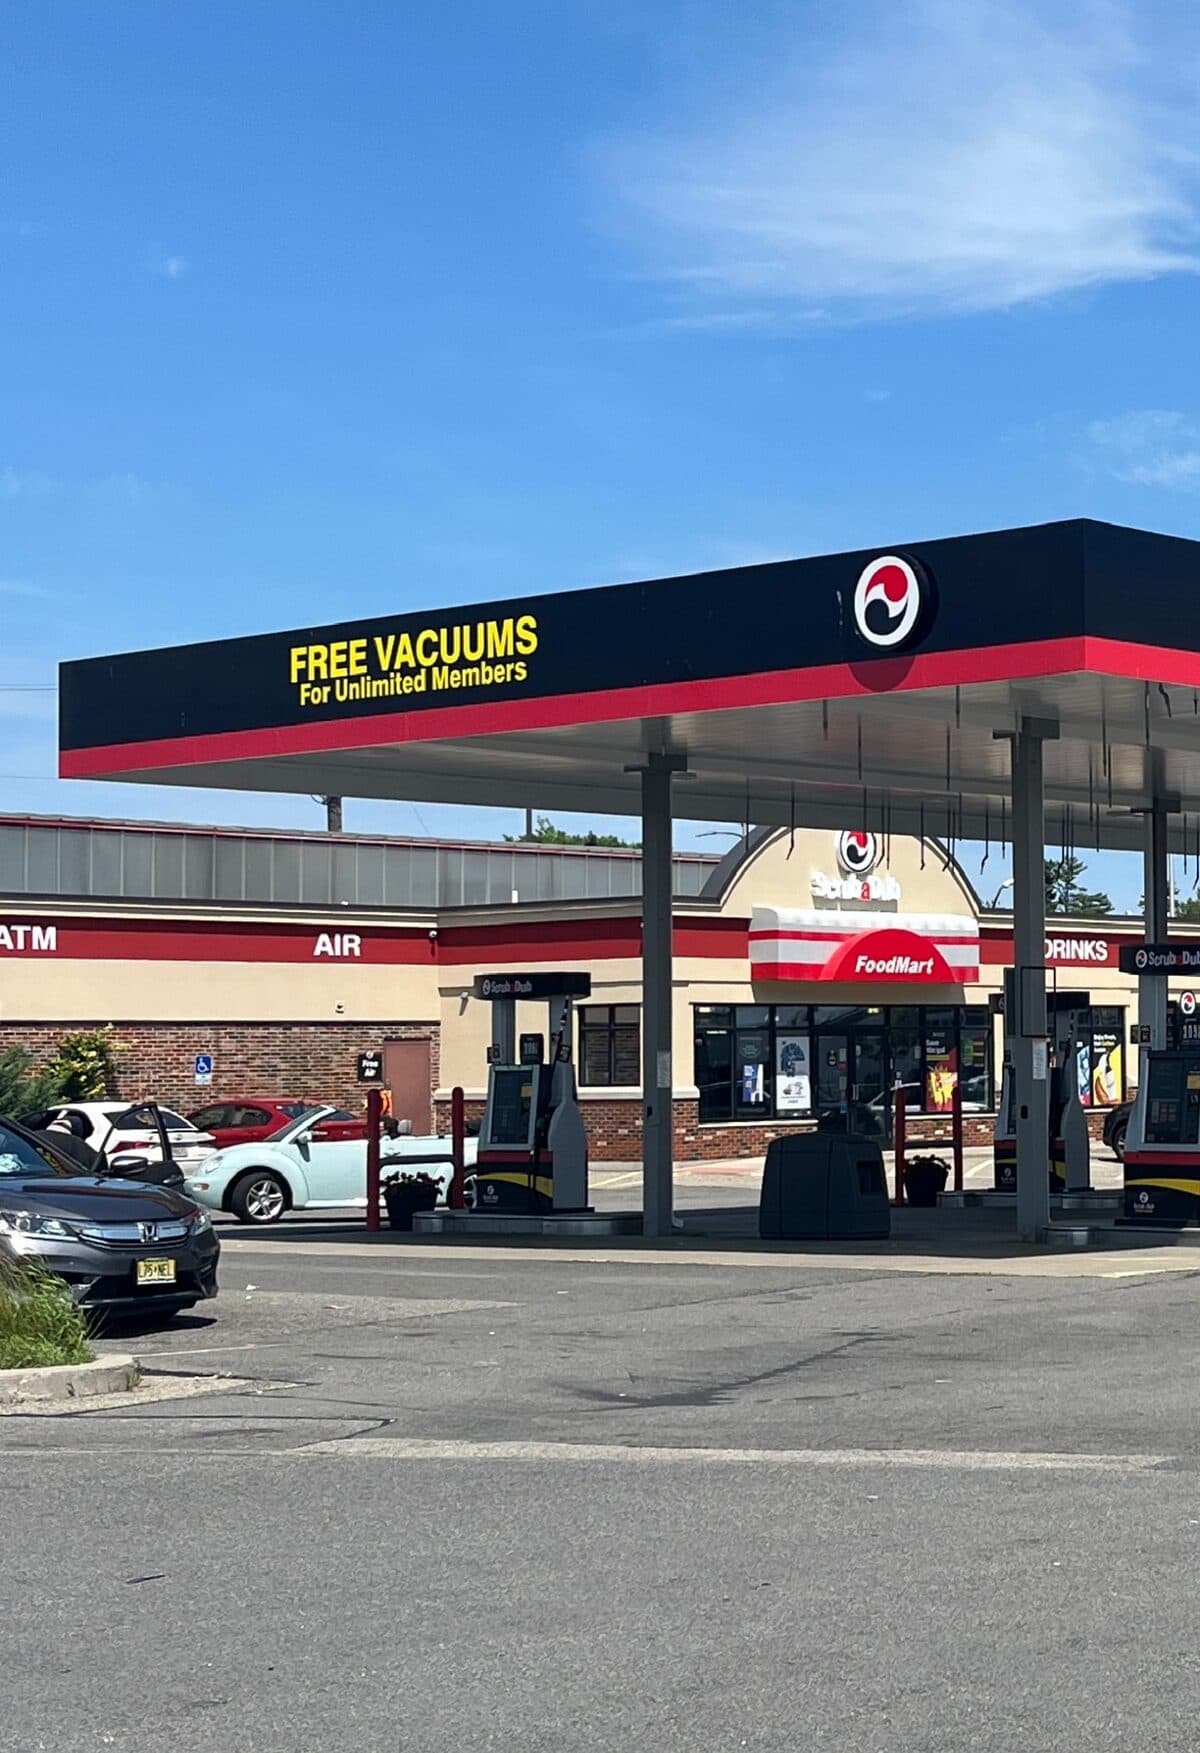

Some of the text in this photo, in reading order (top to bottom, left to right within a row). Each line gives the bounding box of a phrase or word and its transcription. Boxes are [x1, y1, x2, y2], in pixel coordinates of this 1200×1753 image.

[291, 615, 538, 683] FREE VACUUMS
[300, 660, 527, 706] For Unlimited Members
[0, 924, 57, 951] ATM
[313, 933, 362, 957] AIR
[1044, 938, 1108, 961] DRINKS
[855, 955, 934, 974] FoodMart
